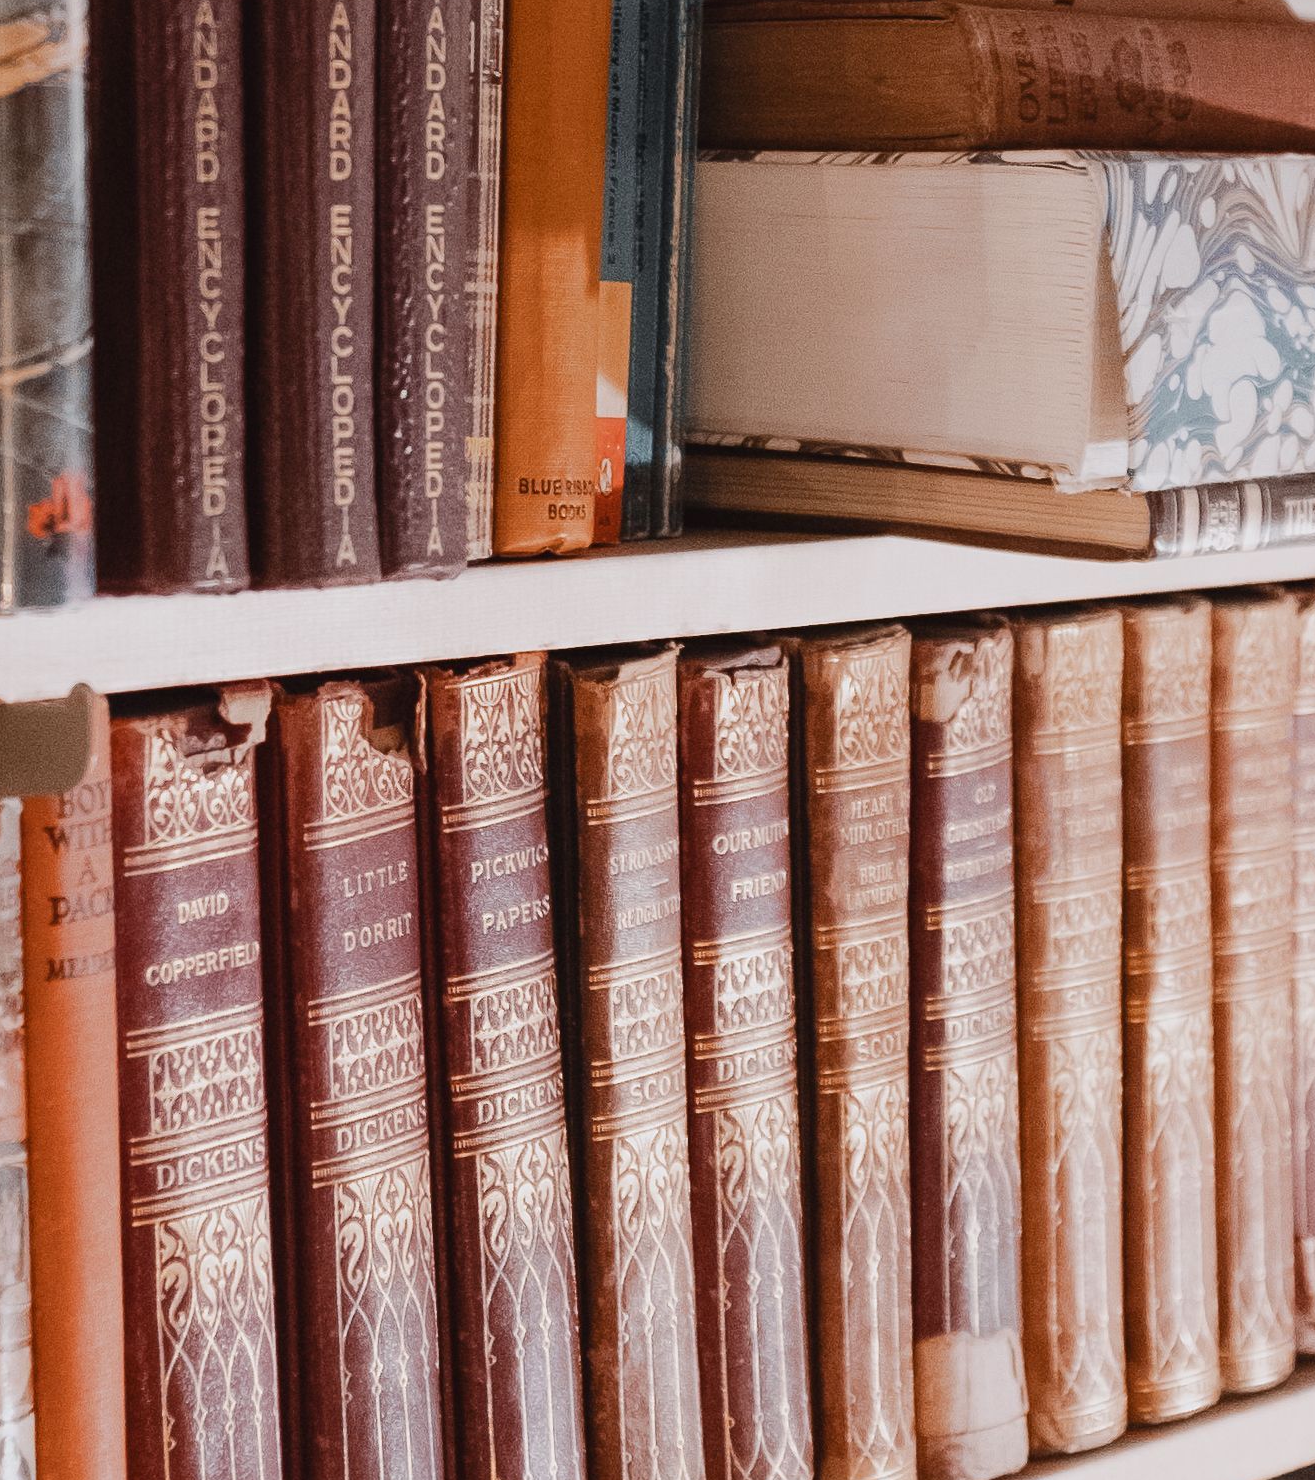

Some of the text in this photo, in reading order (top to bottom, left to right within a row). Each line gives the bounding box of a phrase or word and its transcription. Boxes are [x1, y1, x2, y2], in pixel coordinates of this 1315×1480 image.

[194, 205, 231, 579] ENCYCLOPEDIA
[329, 203, 359, 567] ENCYCLOPEDIA
[423, 203, 447, 557] ENCYCLOPEDIA
[518, 477, 596, 496] BLUE RIBBO
[547, 503, 587, 521] BOOKS
[850, 794, 894, 820] HEART
[973, 781, 998, 805] OLD
[712, 815, 789, 855] OUR MUTU
[839, 816, 910, 842] MIDLOTHI
[77, 855, 98, 887] A
[342, 860, 409, 899] LITTLE
[176, 891, 231, 925] DAVID
[481, 895, 552, 935] PAPERS
[342, 911, 414, 954] DORRIT
[144, 940, 261, 987] COPPERFIELD
[1065, 983, 1116, 1009] SCOT
[716, 1041, 797, 1082] DICKEN
[855, 1029, 908, 1062] SCOT
[476, 1071, 564, 1125] DICKENS
[627, 1067, 686, 1105] SCOT
[336, 1098, 427, 1153] DICKENS
[155, 1140, 266, 1191] DICKENS
